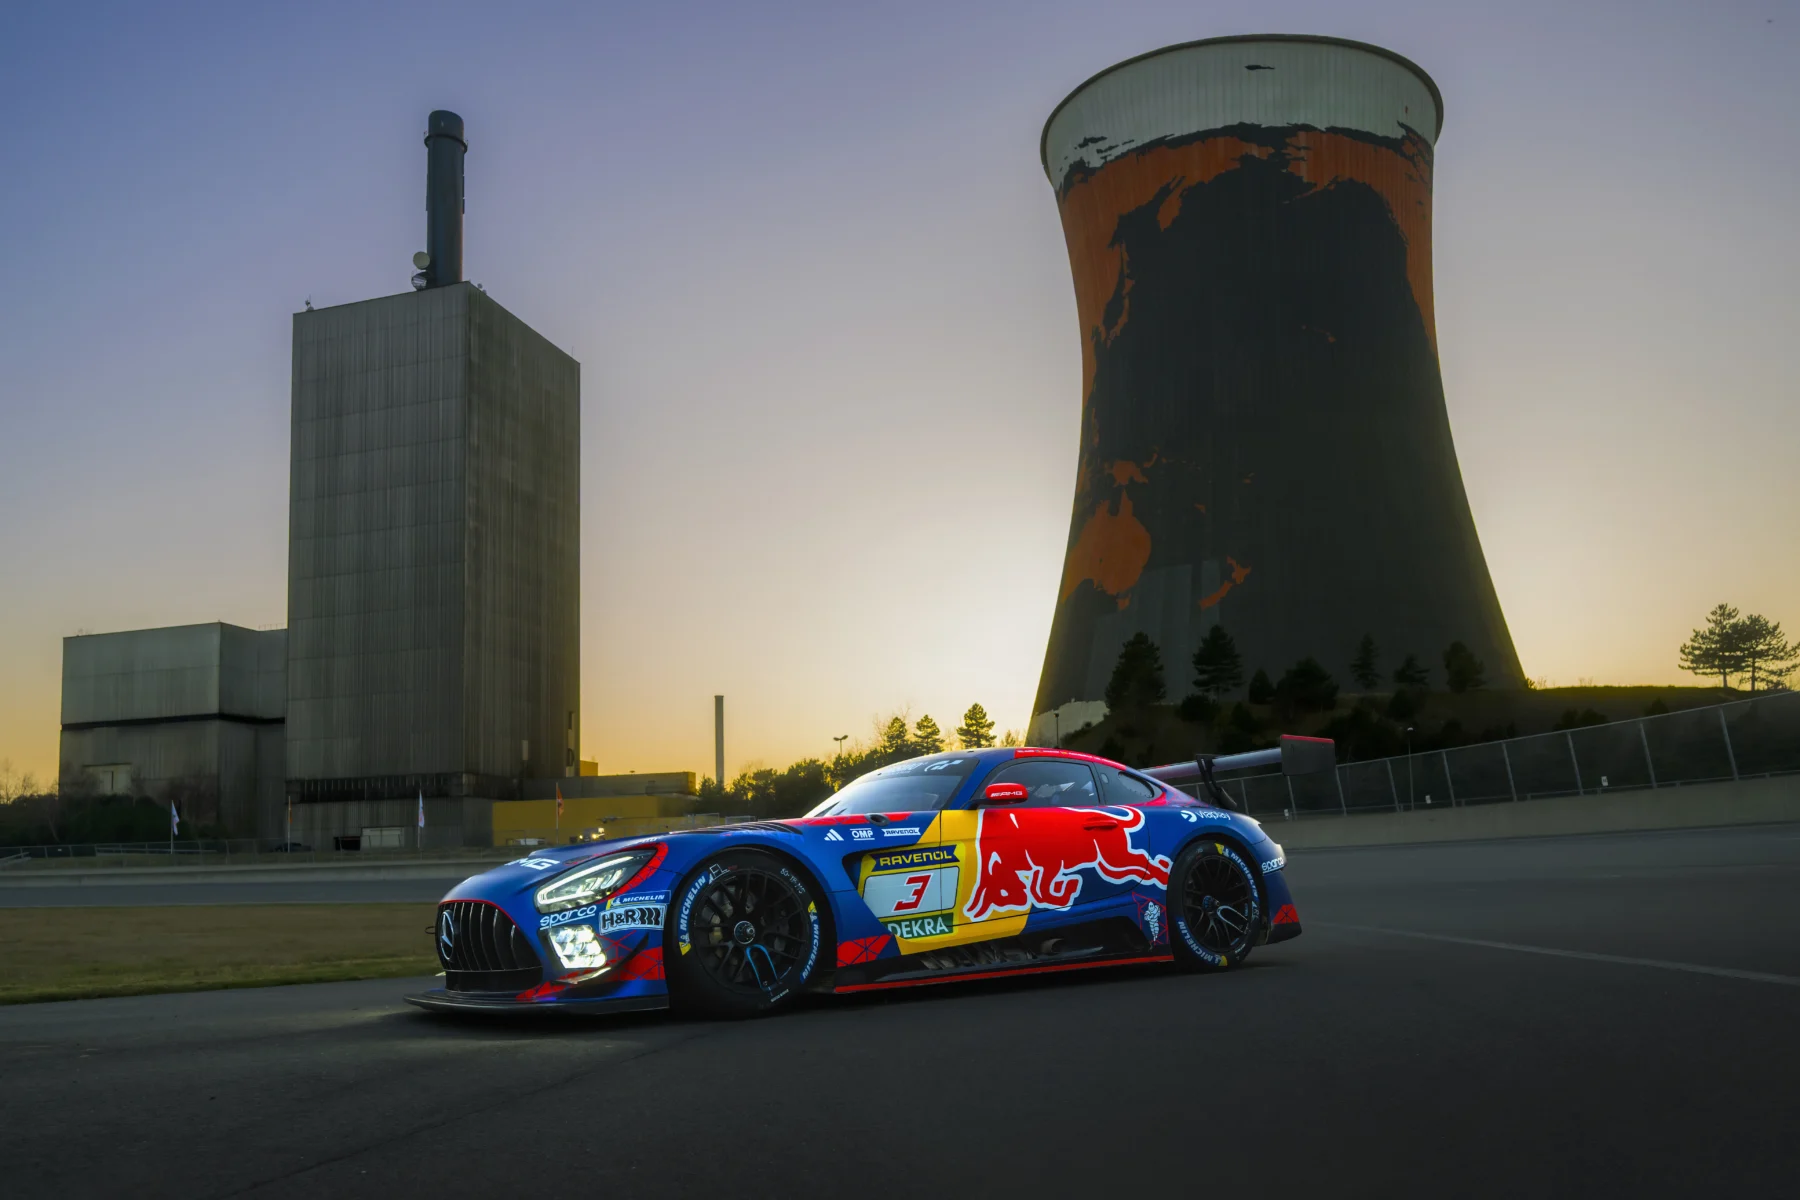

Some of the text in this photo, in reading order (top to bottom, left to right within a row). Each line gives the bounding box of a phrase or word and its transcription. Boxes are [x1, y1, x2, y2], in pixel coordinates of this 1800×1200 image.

[851, 829, 874, 839] OMP
[885, 828, 917, 836] RAVENOL
[504, 857, 561, 871] MG
[879, 850, 953, 866] RAVENOL
[1230, 853, 1258, 898] MICHELIN
[622, 894, 665, 903] MICHELIN
[680, 875, 706, 931] MICHELIN
[892, 873, 933, 912] 3
[539, 904, 597, 928] sparco
[601, 908, 637, 931] H&R
[887, 916, 949, 939] DEKRA
[802, 924, 819, 980] MICHELIN
[1178, 921, 1213, 963] MICHELIN
